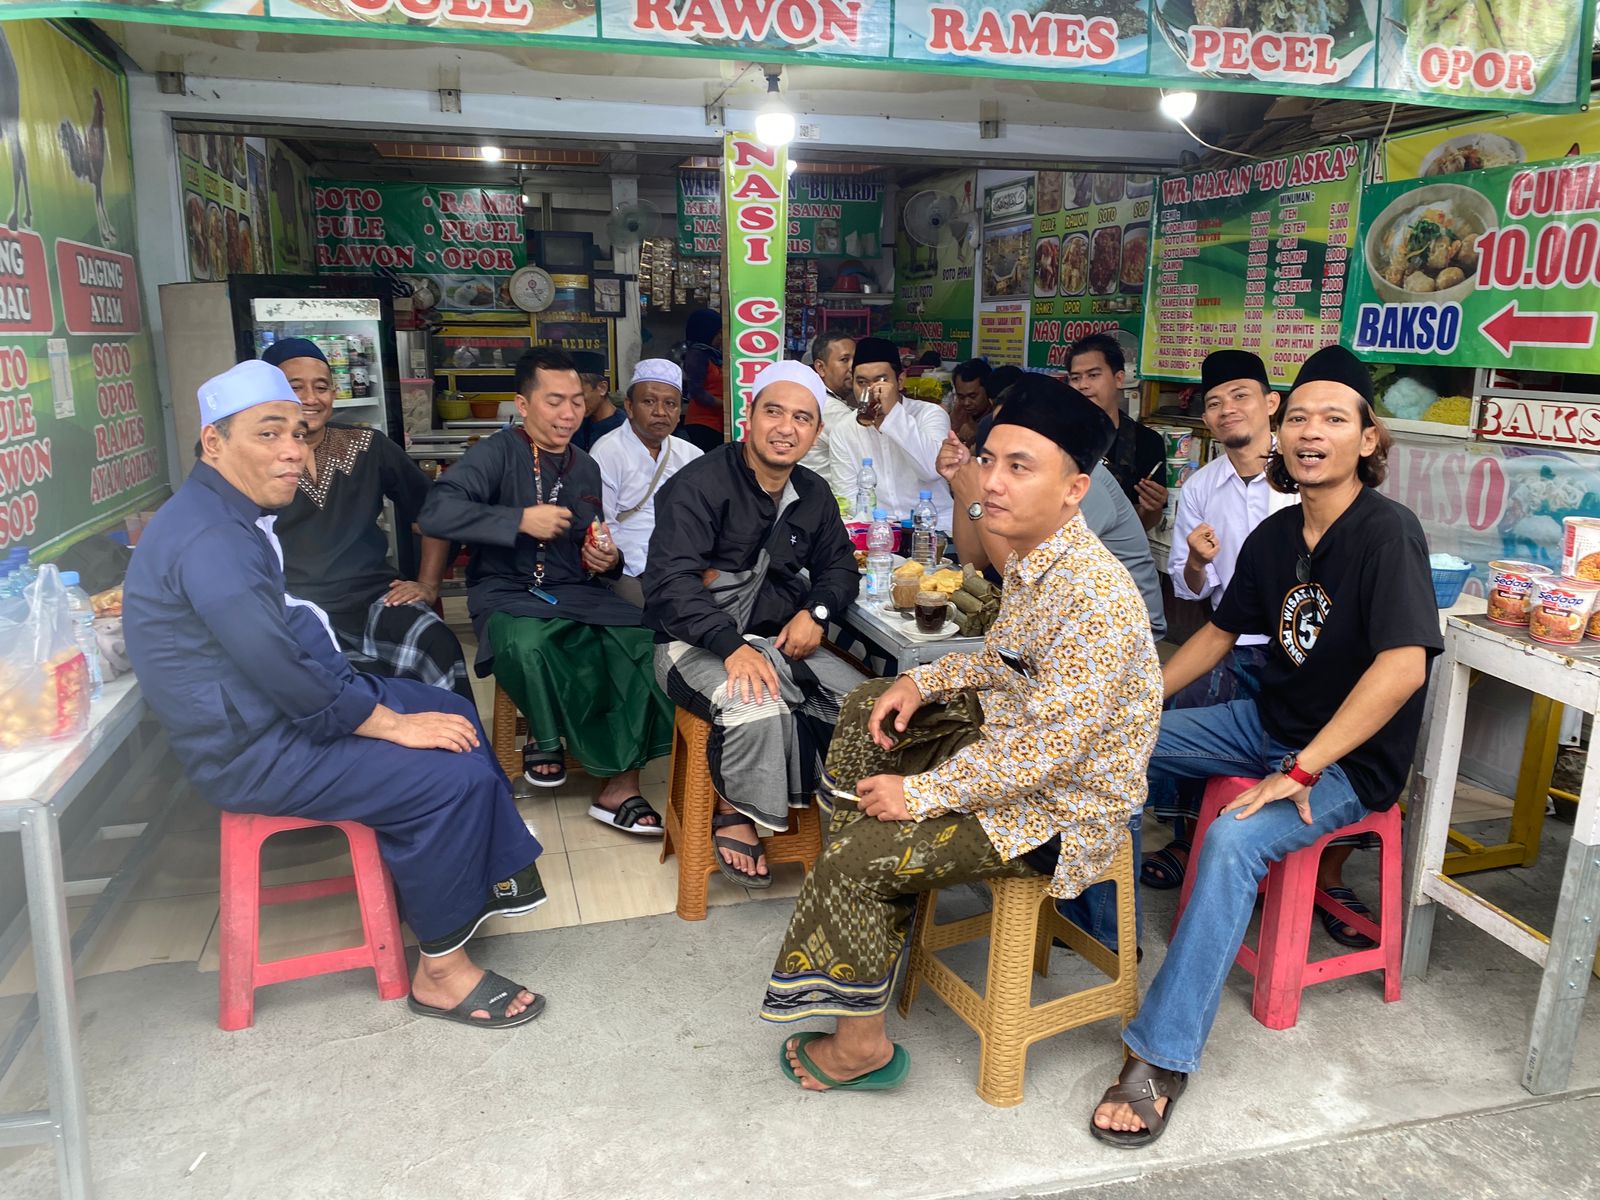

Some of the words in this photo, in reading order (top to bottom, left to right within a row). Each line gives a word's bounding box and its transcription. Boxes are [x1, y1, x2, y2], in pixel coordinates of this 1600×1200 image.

[633, 0, 861, 42] RAWON
[929, 8, 1117, 60] RAMES
[1190, 29, 1338, 76] PECEL
[1419, 46, 1535, 92] OPOR
[1162, 179, 1192, 205] WR.
[1193, 168, 1252, 201] MAKAN
[315, 188, 382, 211] SOTO
[732, 140, 781, 263] NASI
[1098, 207, 1117, 223] SOTO
[1133, 201, 1150, 218] SOP
[317, 216, 384, 239] GULE
[441, 219, 524, 244] PECEL
[1283, 223, 1291, 233] ES
[1293, 222, 1306, 233] TEH
[1283, 237, 1297, 248] KOPI
[320, 244, 414, 268] RAWON
[443, 247, 515, 269] OPOR
[1281, 252, 1289, 262] ES
[1290, 251, 1307, 261] KOPI
[1477, 223, 1600, 286] 10.00
[76, 254, 124, 289] DAGING
[1162, 272, 1178, 283] GULE
[1280, 266, 1301, 277] JERUK
[1179, 284, 1199, 294] TELUR
[1279, 281, 1287, 291] ES
[1288, 280, 1312, 291] JERUK
[90, 295, 124, 324] AYAM
[1064, 301, 1081, 313] OPOR
[1279, 295, 1295, 306] SUSU
[1321, 294, 1342, 306] 5.000
[1277, 310, 1285, 319] ES
[1286, 310, 1304, 319] SUSU
[1321, 308, 1341, 320] 5.000
[1033, 320, 1060, 341] NASI
[1160, 323, 1175, 332] PECEL
[1219, 324, 1237, 333] TELUR
[1243, 324, 1262, 334] 15.000
[1276, 324, 1291, 334] KOPI
[1292, 324, 1315, 334] WHITE
[1321, 324, 1339, 335] 5.000
[1356, 305, 1460, 351] BAKSO
[561, 338, 601, 349] REBUS
[1160, 336, 1175, 344] PECEL
[1242, 337, 1260, 347] 20.000
[1275, 338, 1290, 348] KOPI
[1291, 338, 1314, 348] HITAM
[92, 344, 131, 377] SOTO
[1047, 345, 1072, 366] AY
[1274, 352, 1292, 362] GOOD
[1293, 353, 1308, 363] DAY
[1272, 367, 1285, 376] DLL
[98, 381, 137, 417] OPOR
[95, 416, 145, 460] RAMES
[0, 440, 52, 493] WON
[91, 460, 122, 503] AYAM
[1538, 591, 1584, 606] Sedaap
